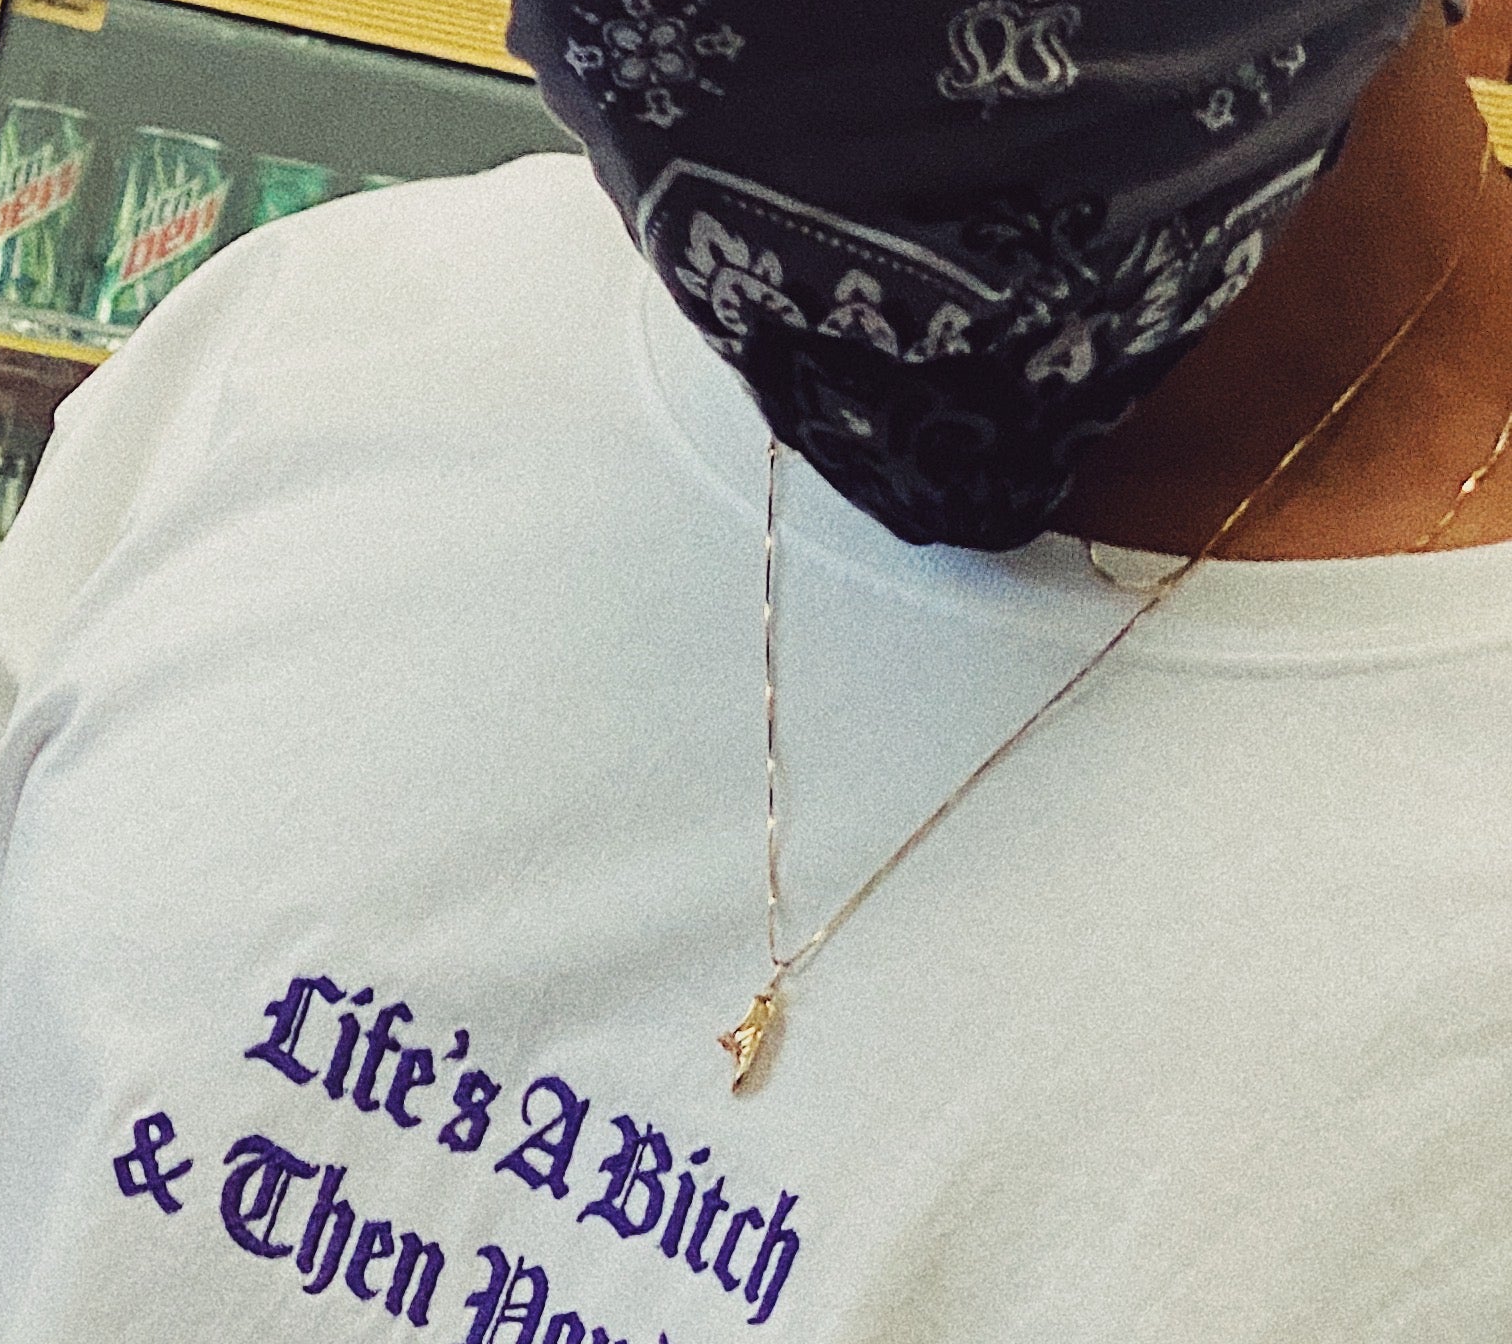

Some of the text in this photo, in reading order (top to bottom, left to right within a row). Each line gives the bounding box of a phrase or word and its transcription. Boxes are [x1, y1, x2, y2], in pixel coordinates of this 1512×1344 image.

[113, 1111, 193, 1214] &
[219, 1133, 446, 1328] Then
[244, 975, 801, 1325] Life's A Bitch
